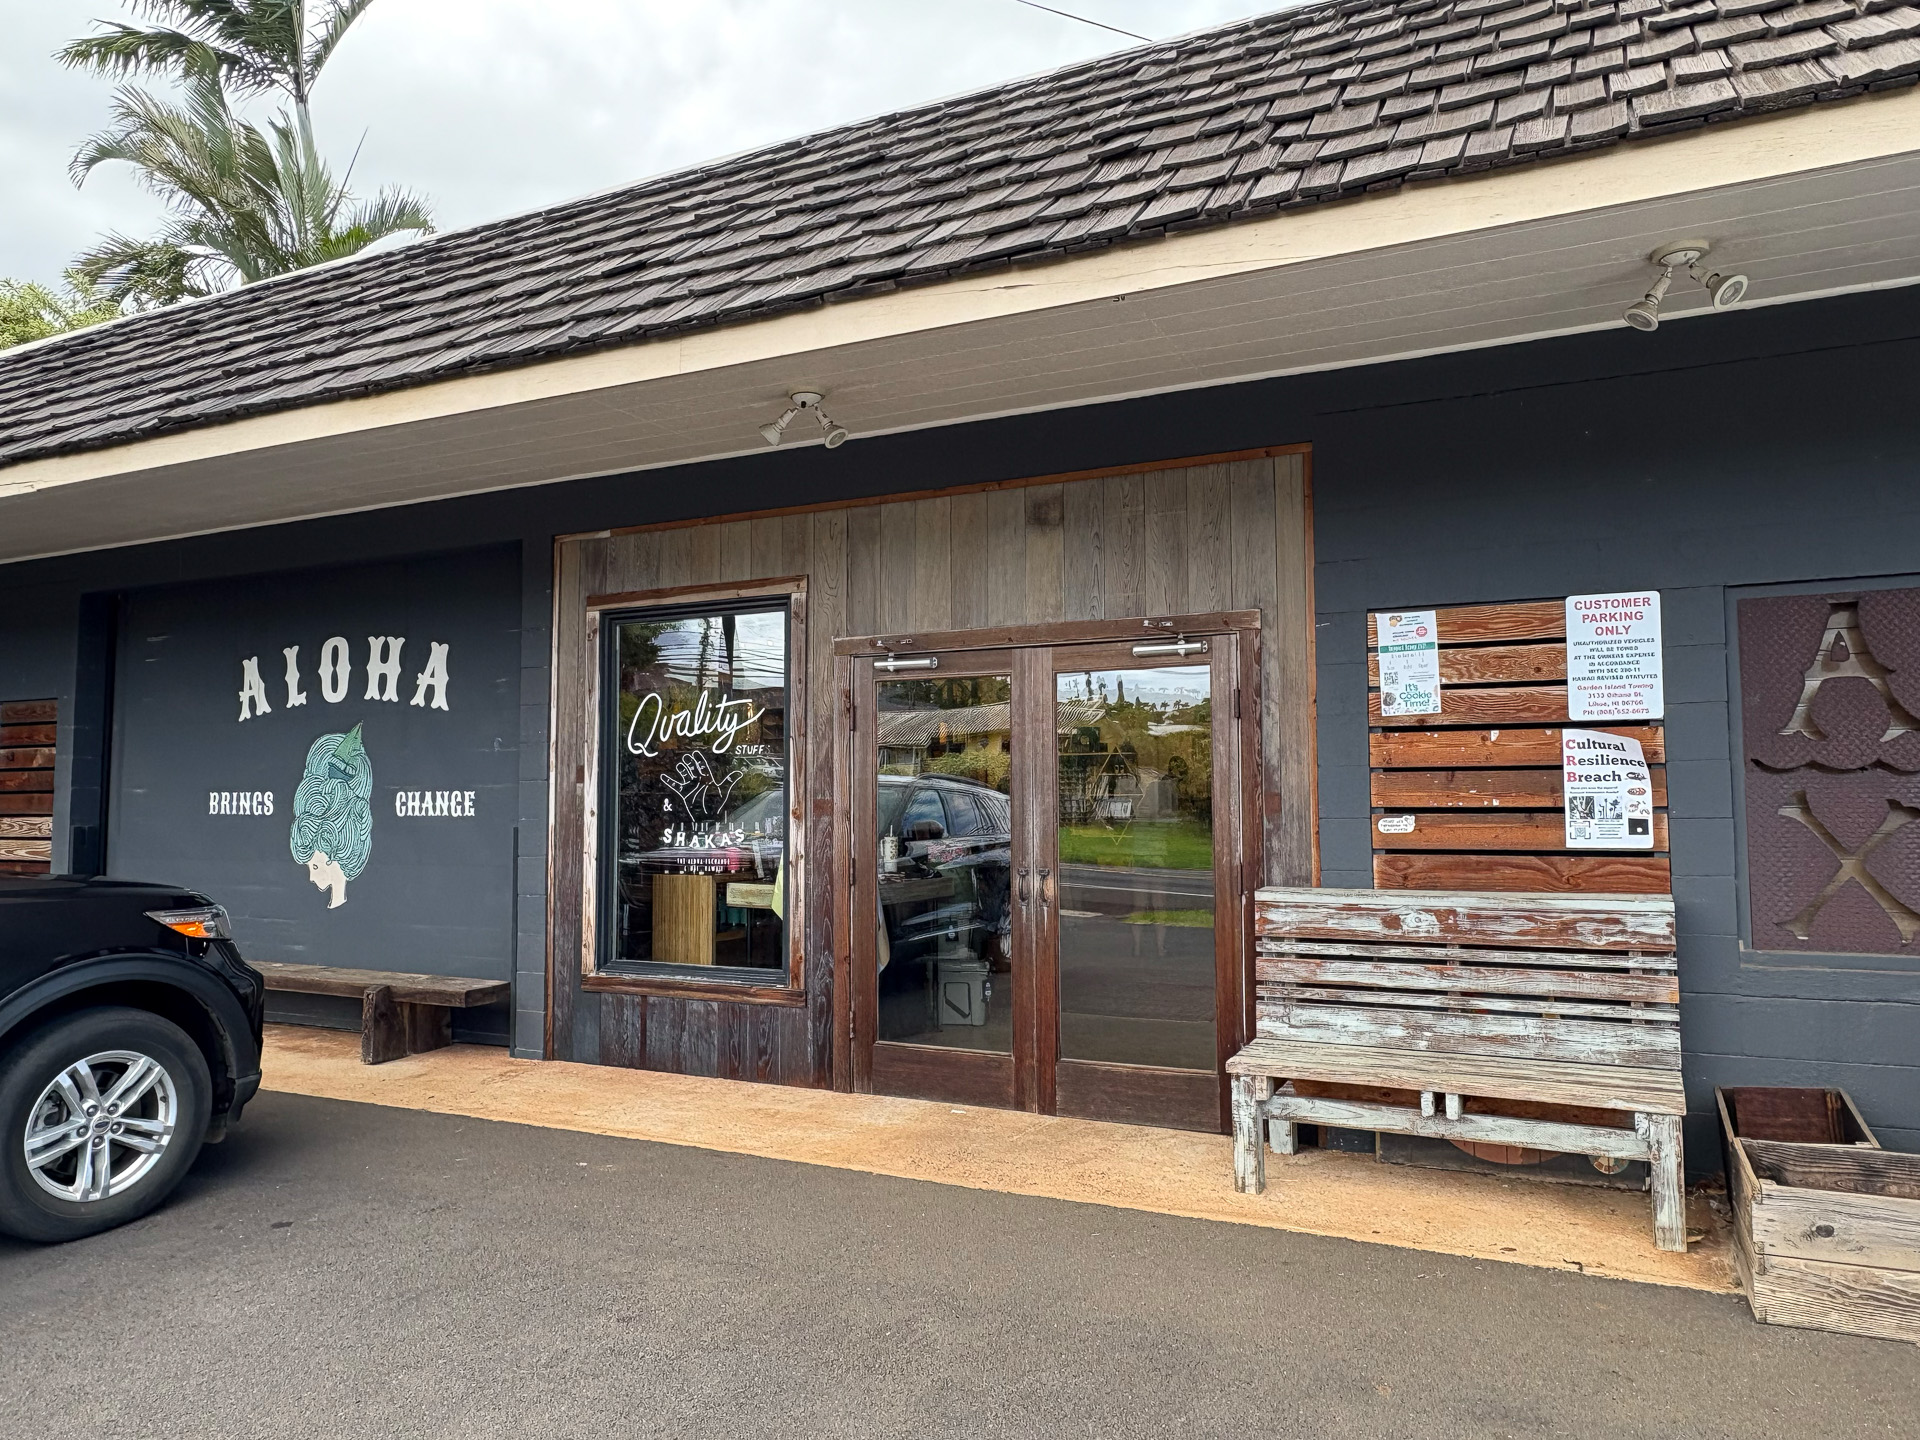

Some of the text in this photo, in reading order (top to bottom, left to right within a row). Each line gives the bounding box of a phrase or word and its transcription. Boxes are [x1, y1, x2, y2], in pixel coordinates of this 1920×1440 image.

[1574, 597, 1651, 610] CUSTOMER
[1582, 611, 1644, 623] PARKING
[1595, 625, 1631, 636] ONLY
[238, 636, 449, 722] ALOHA
[1405, 683, 1418, 691] It's
[1400, 690, 1432, 699] Cookie
[1403, 699, 1430, 707] Time!
[627, 690, 765, 757] Quality
[1565, 738, 1626, 752] Cultural
[1566, 754, 1645, 767] Resilience
[1566, 771, 1622, 782] Breach
[208, 791, 476, 817] BRINGS CHANGE
[663, 798, 672, 811] &
[662, 828, 744, 848] SHAKAS
